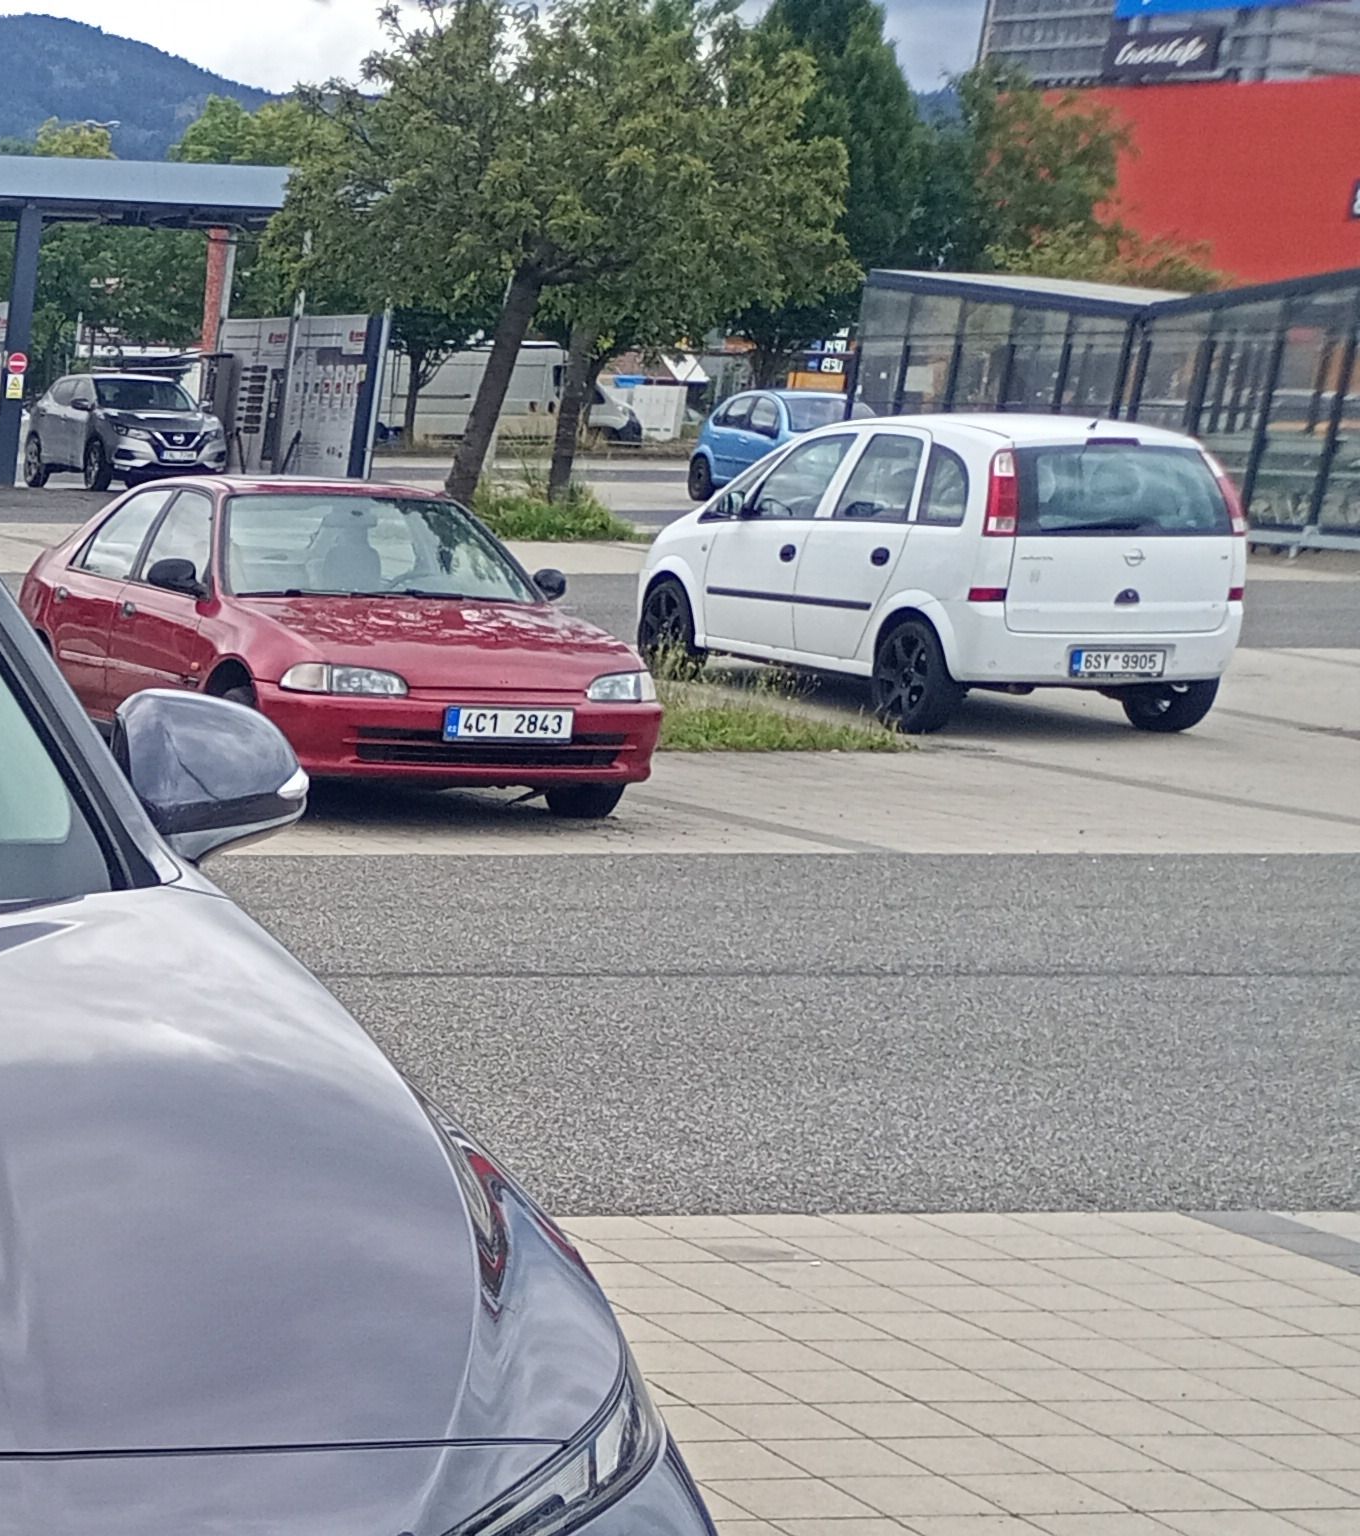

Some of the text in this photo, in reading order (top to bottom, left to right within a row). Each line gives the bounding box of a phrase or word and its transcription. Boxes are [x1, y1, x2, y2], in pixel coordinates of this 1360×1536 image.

[1084, 654, 1158, 670] 6SY 9905
[464, 713, 499, 734] 4C1
[514, 714, 563, 735] 2843
